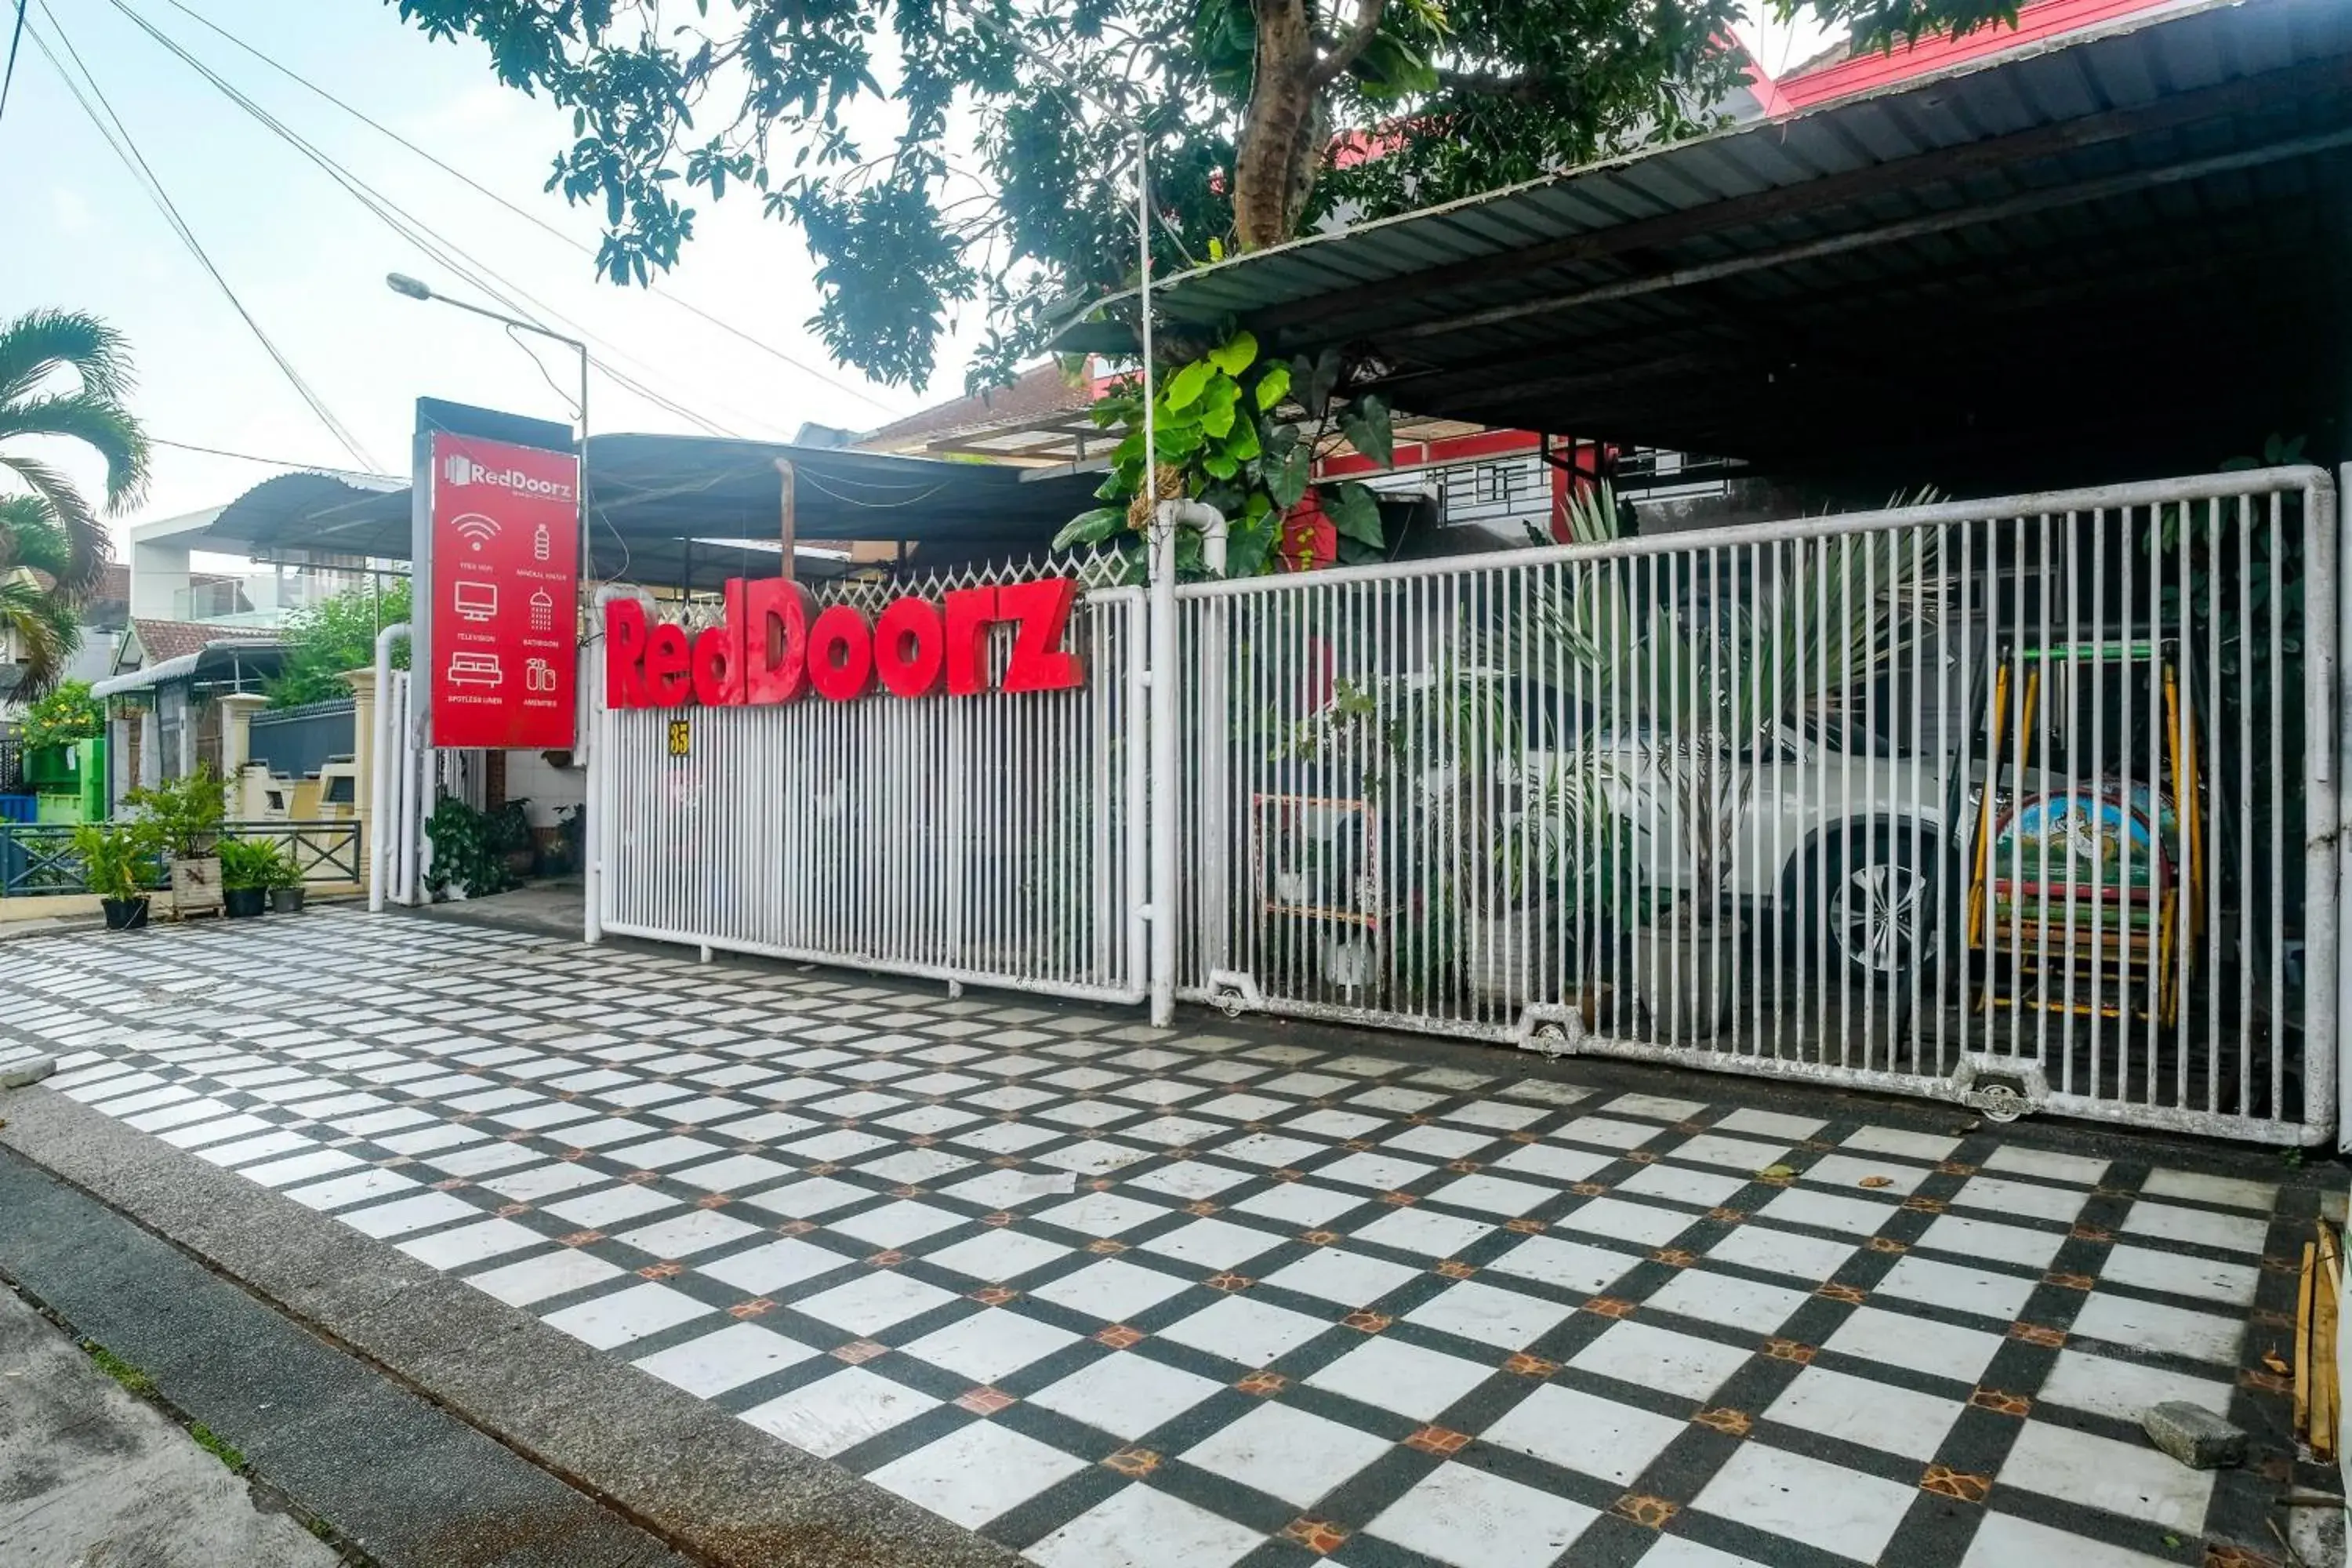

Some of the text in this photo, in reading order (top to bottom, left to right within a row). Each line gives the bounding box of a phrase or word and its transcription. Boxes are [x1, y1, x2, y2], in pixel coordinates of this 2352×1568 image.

[471, 463, 572, 498] RedDoorz
[457, 632, 496, 643] TELEVISION
[605, 576, 1086, 710] RedDoorz
[448, 695, 481, 704] SPOTLESS
[670, 724, 688, 753] 35
